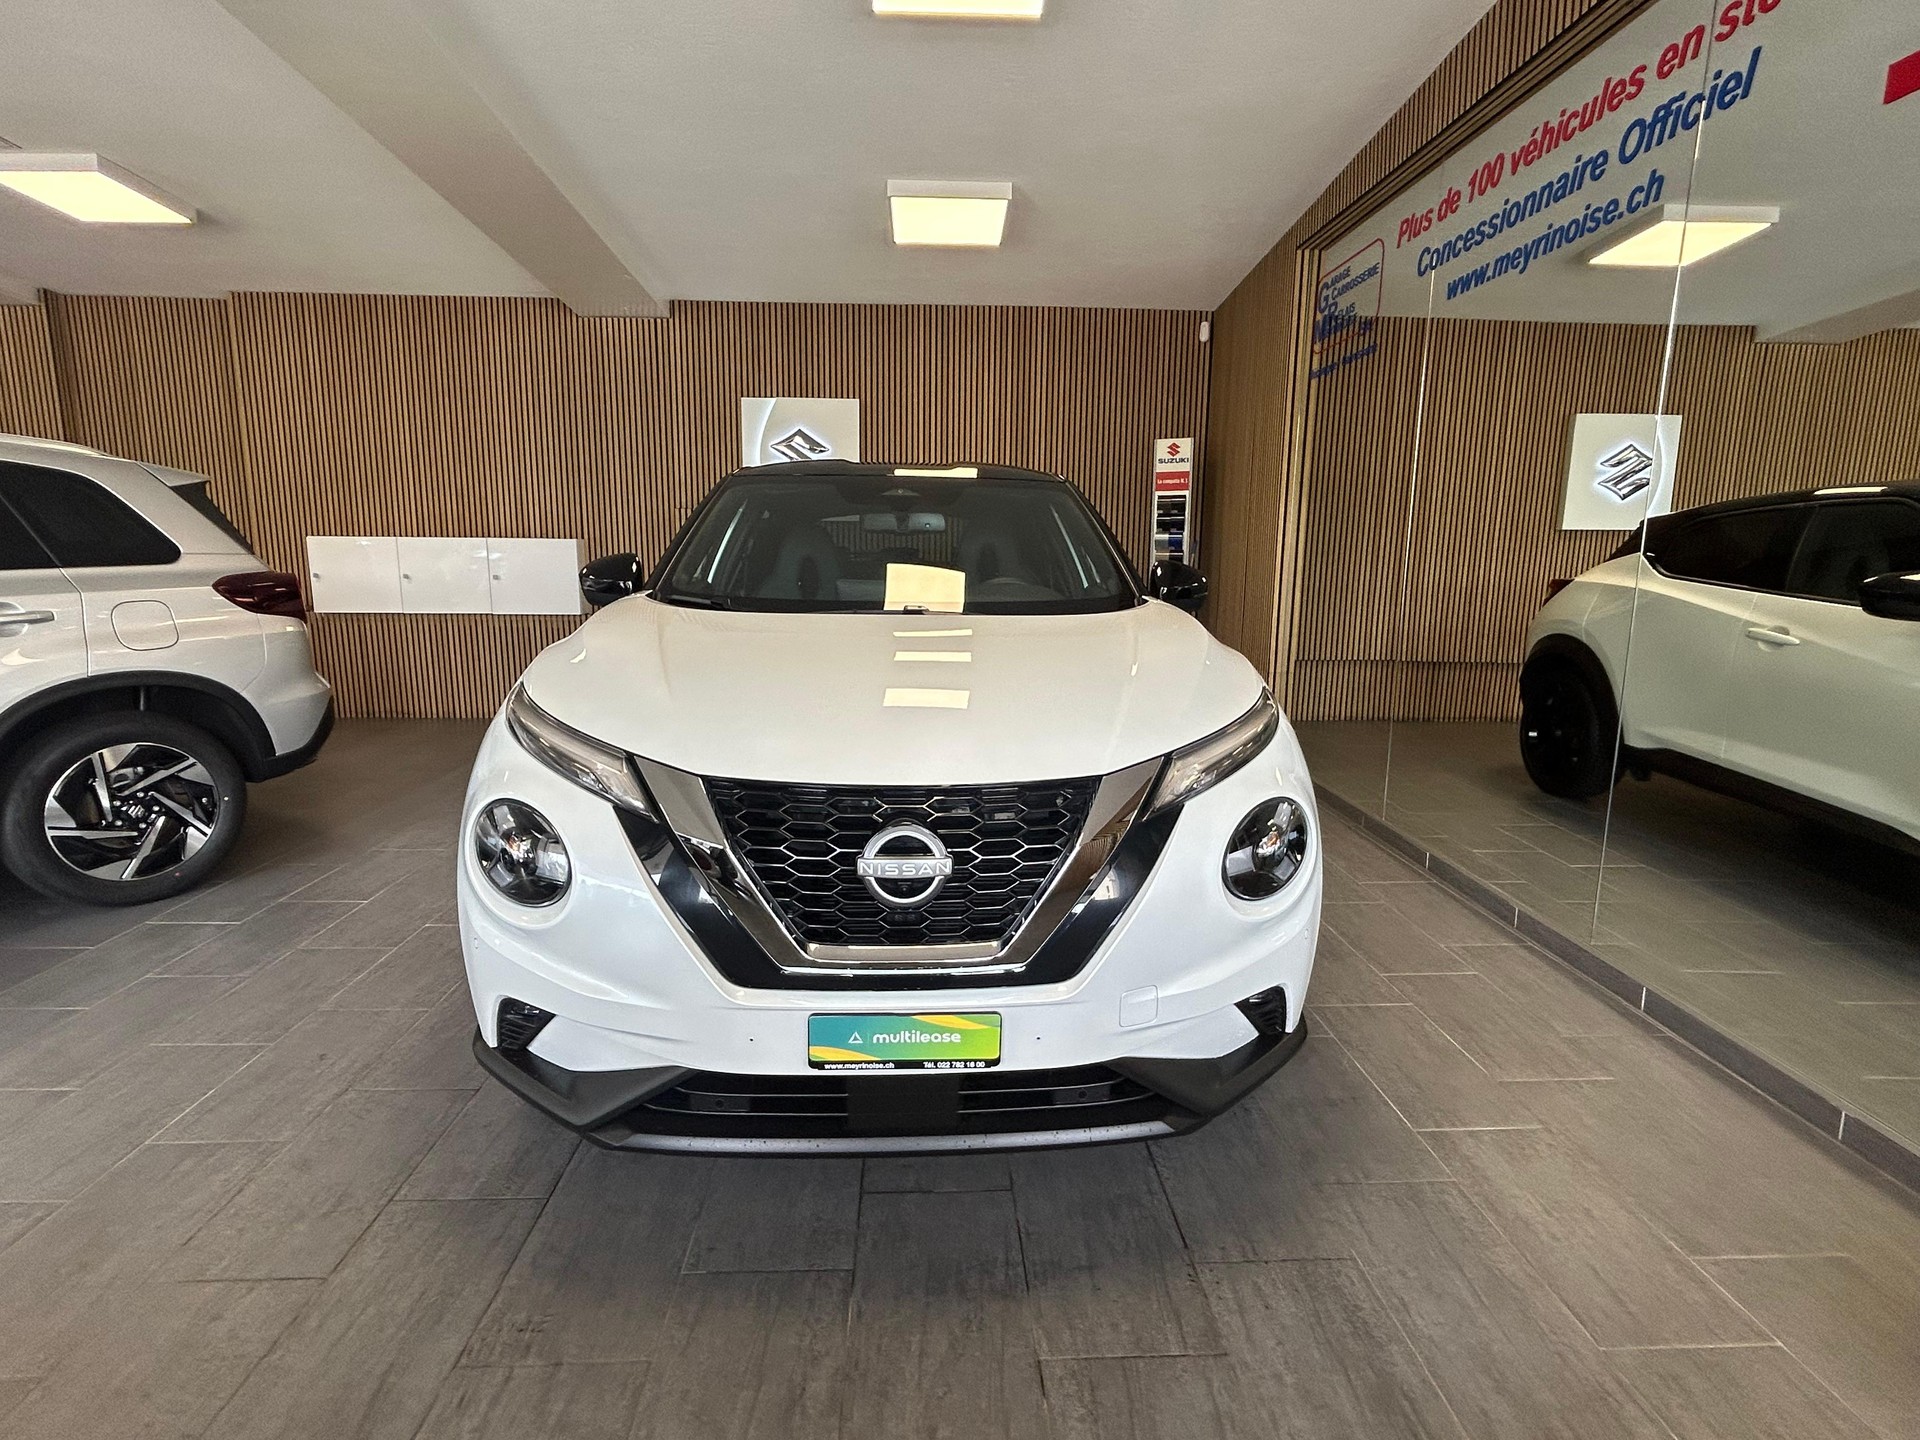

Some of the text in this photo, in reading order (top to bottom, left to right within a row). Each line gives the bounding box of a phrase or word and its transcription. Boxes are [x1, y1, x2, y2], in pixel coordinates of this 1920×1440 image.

[1397, 207, 1434, 249] Plus
[1437, 187, 1462, 222] de
[1468, 152, 1505, 203] 100
[1510, 64, 1647, 176] véhicules
[1656, 24, 1705, 80] en
[1417, 45, 1763, 277] Concessionnaire Officiel
[1447, 168, 1665, 300] www.meyrinoise.ch
[859, 861, 951, 876] NISSAN
[873, 1030, 961, 1043] multilease
[824, 1062, 895, 1070] www.meyrinoise.ch
[936, 1061, 951, 1070] 022
[975, 1061, 985, 1070] 00
